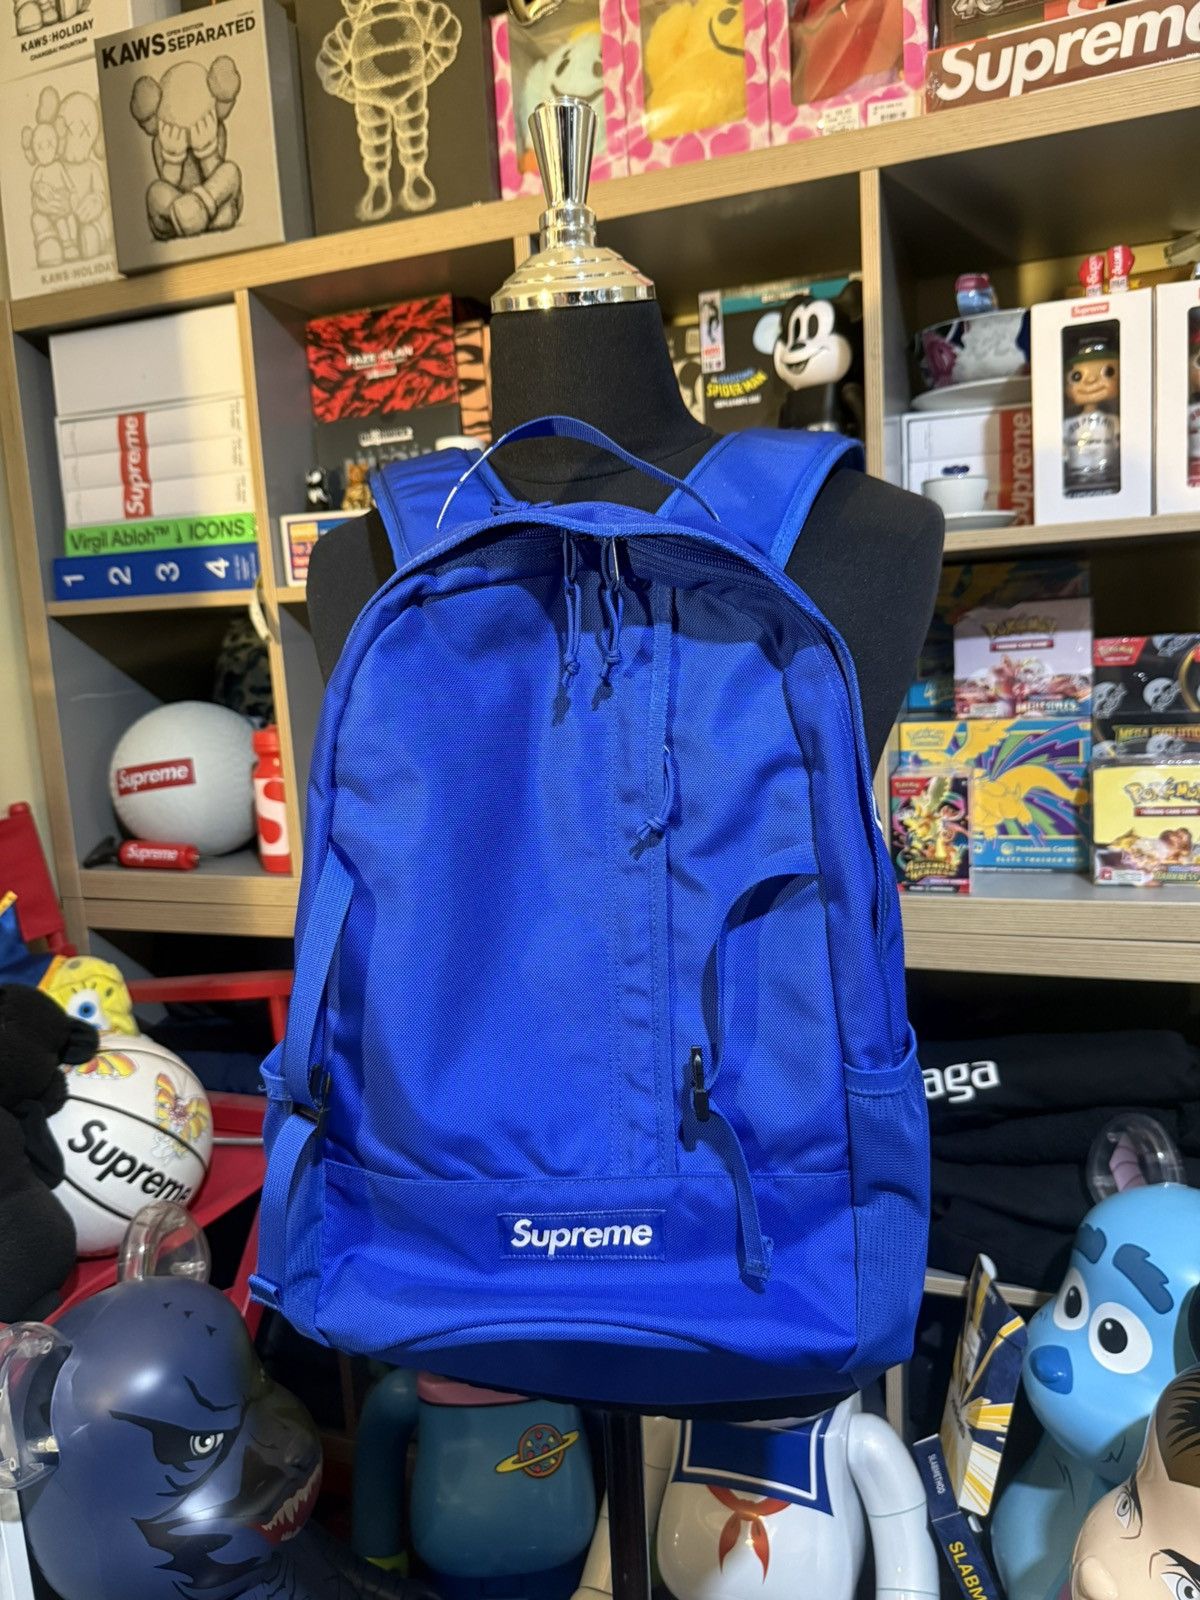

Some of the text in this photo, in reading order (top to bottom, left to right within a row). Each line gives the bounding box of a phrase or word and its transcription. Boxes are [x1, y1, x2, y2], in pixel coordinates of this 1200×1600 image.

[166, 28, 181, 37] OPEN
[168, 17, 256, 53] SEPARATED
[102, 33, 166, 69] KAWS
[125, 415, 150, 516] Supreme
[70, 529, 109, 553] Virgil
[189, 519, 246, 539] ICONS
[62, 572, 85, 587] 1
[108, 565, 132, 585] 2
[156, 561, 180, 582] 3
[205, 557, 230, 578] 4
[118, 764, 190, 792] Supreme
[126, 843, 178, 863] Supreme
[511, 1219, 653, 1255] Supreme
